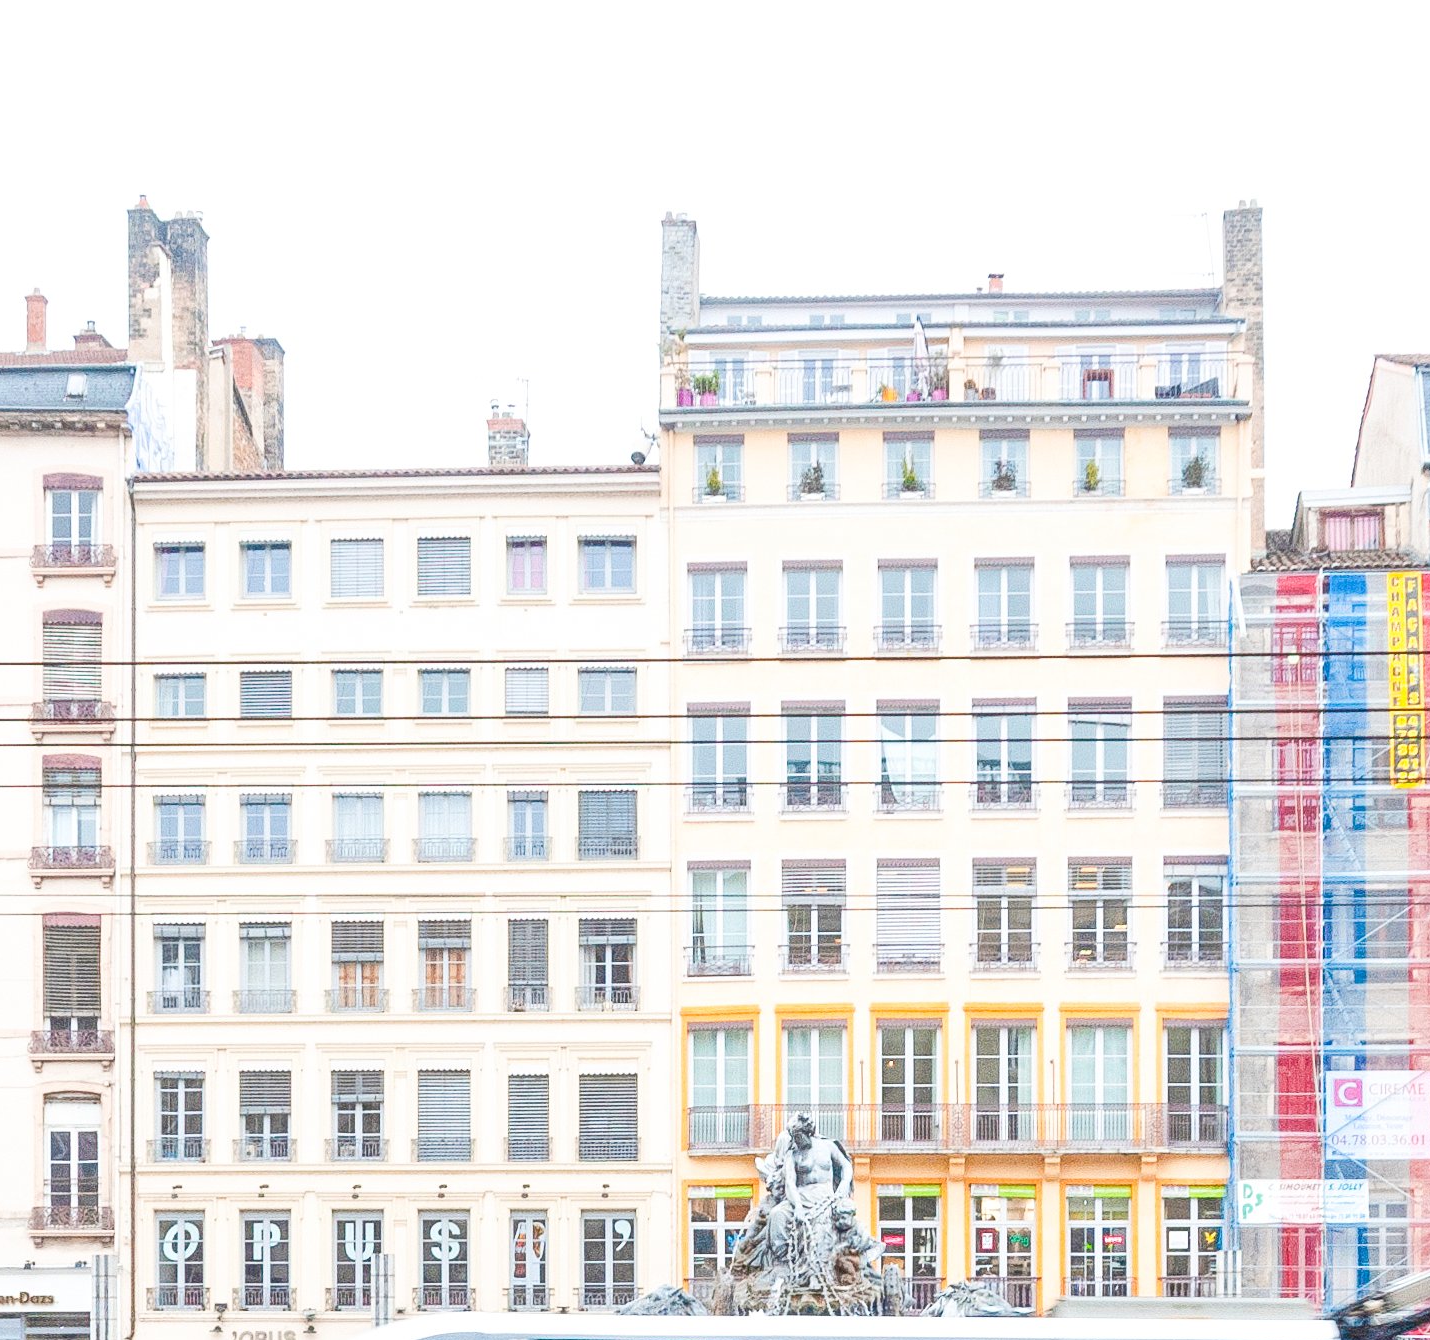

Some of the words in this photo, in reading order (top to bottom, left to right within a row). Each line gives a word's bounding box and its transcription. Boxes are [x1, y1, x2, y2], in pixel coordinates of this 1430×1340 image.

[1338, 1081, 1359, 1105] C
[1368, 1082, 1426, 1096] CIREME
[1331, 1134, 1426, 1146] 04.78.03.36.01
